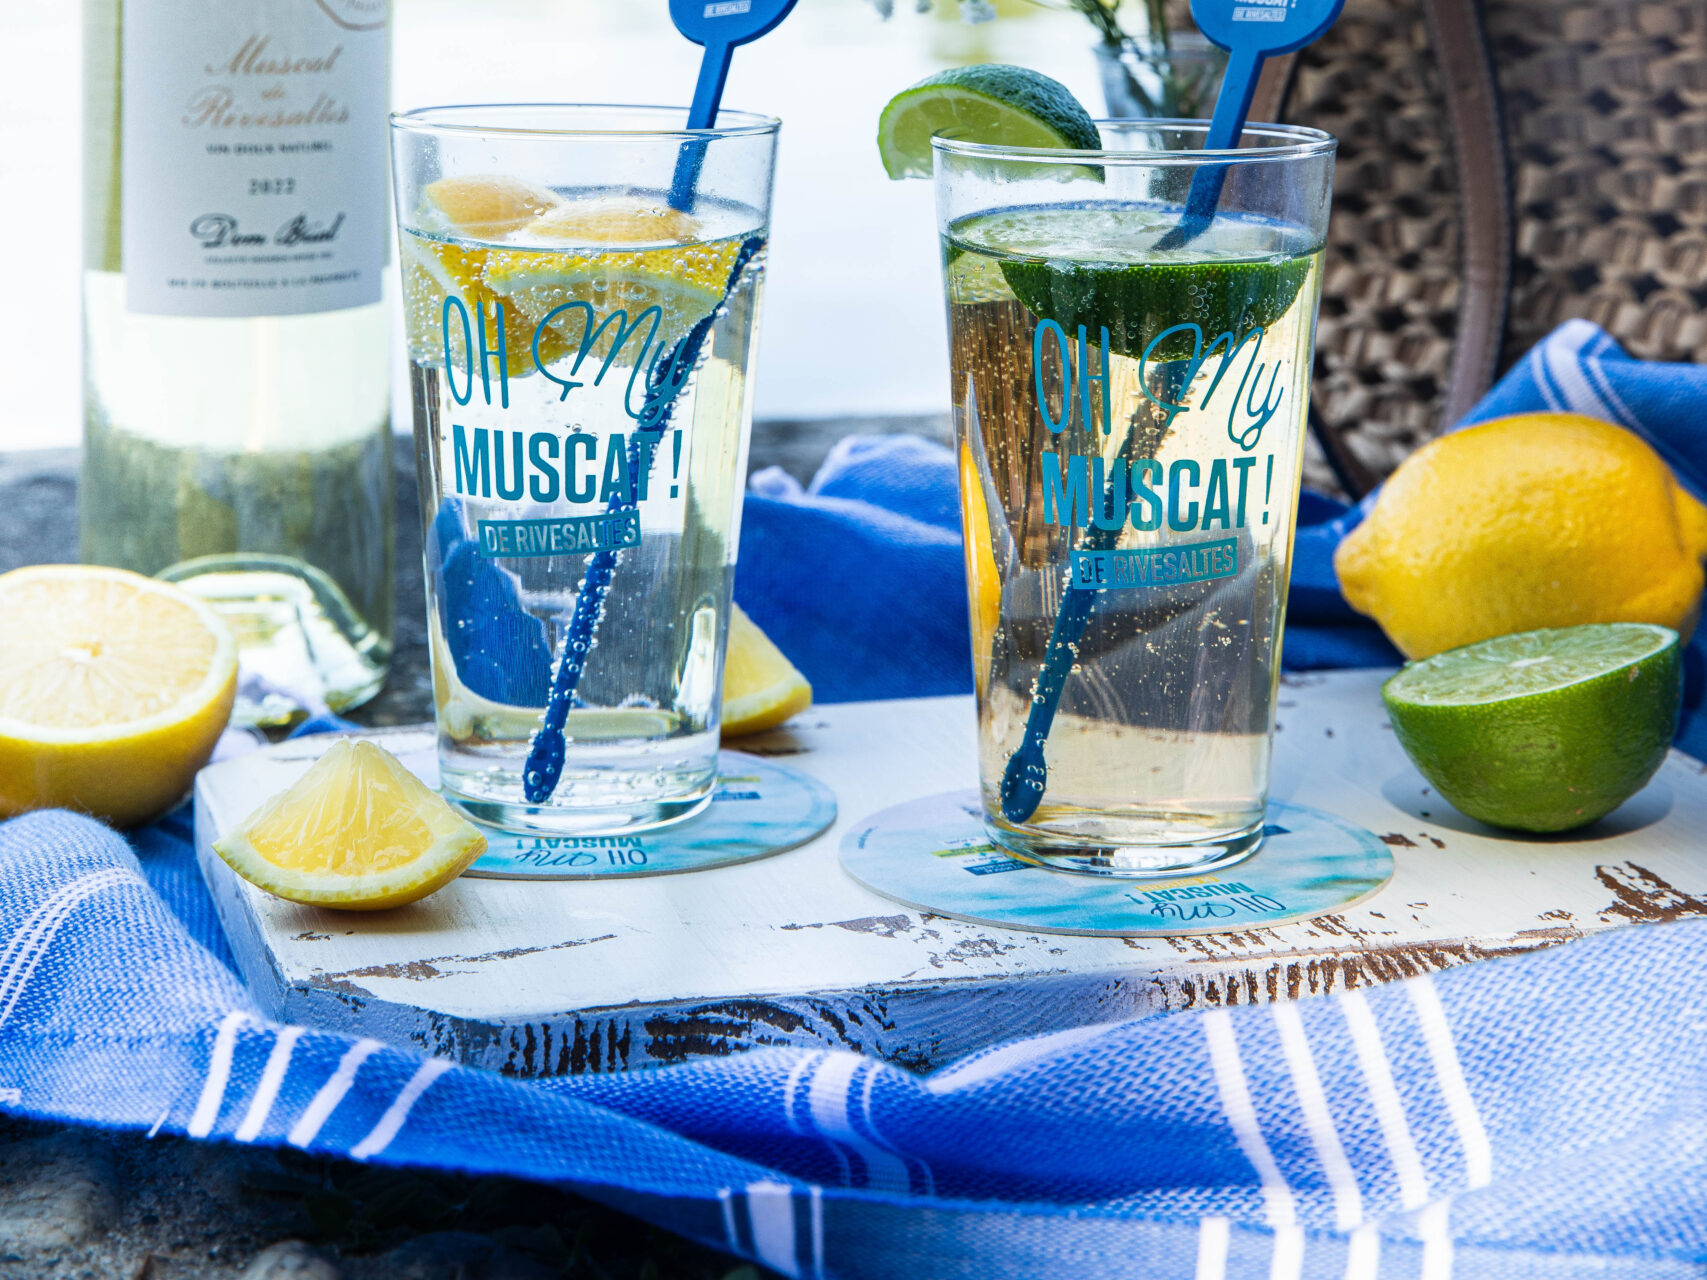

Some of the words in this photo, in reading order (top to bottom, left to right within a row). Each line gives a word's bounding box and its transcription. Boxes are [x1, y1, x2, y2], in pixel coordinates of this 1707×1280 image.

[249, 177, 296, 196] 2022
[442, 295, 509, 409] OH
[532, 300, 694, 426] My
[1034, 318, 1111, 435] OH
[1138, 322, 1284, 451] My
[485, 524, 512, 552] DE
[515, 517, 637, 551] RIVESALTES
[1081, 555, 1105, 583] DE
[1113, 544, 1234, 584] RIVESALTES
[1151, 902, 1236, 920] My
[1230, 894, 1287, 913] OH
